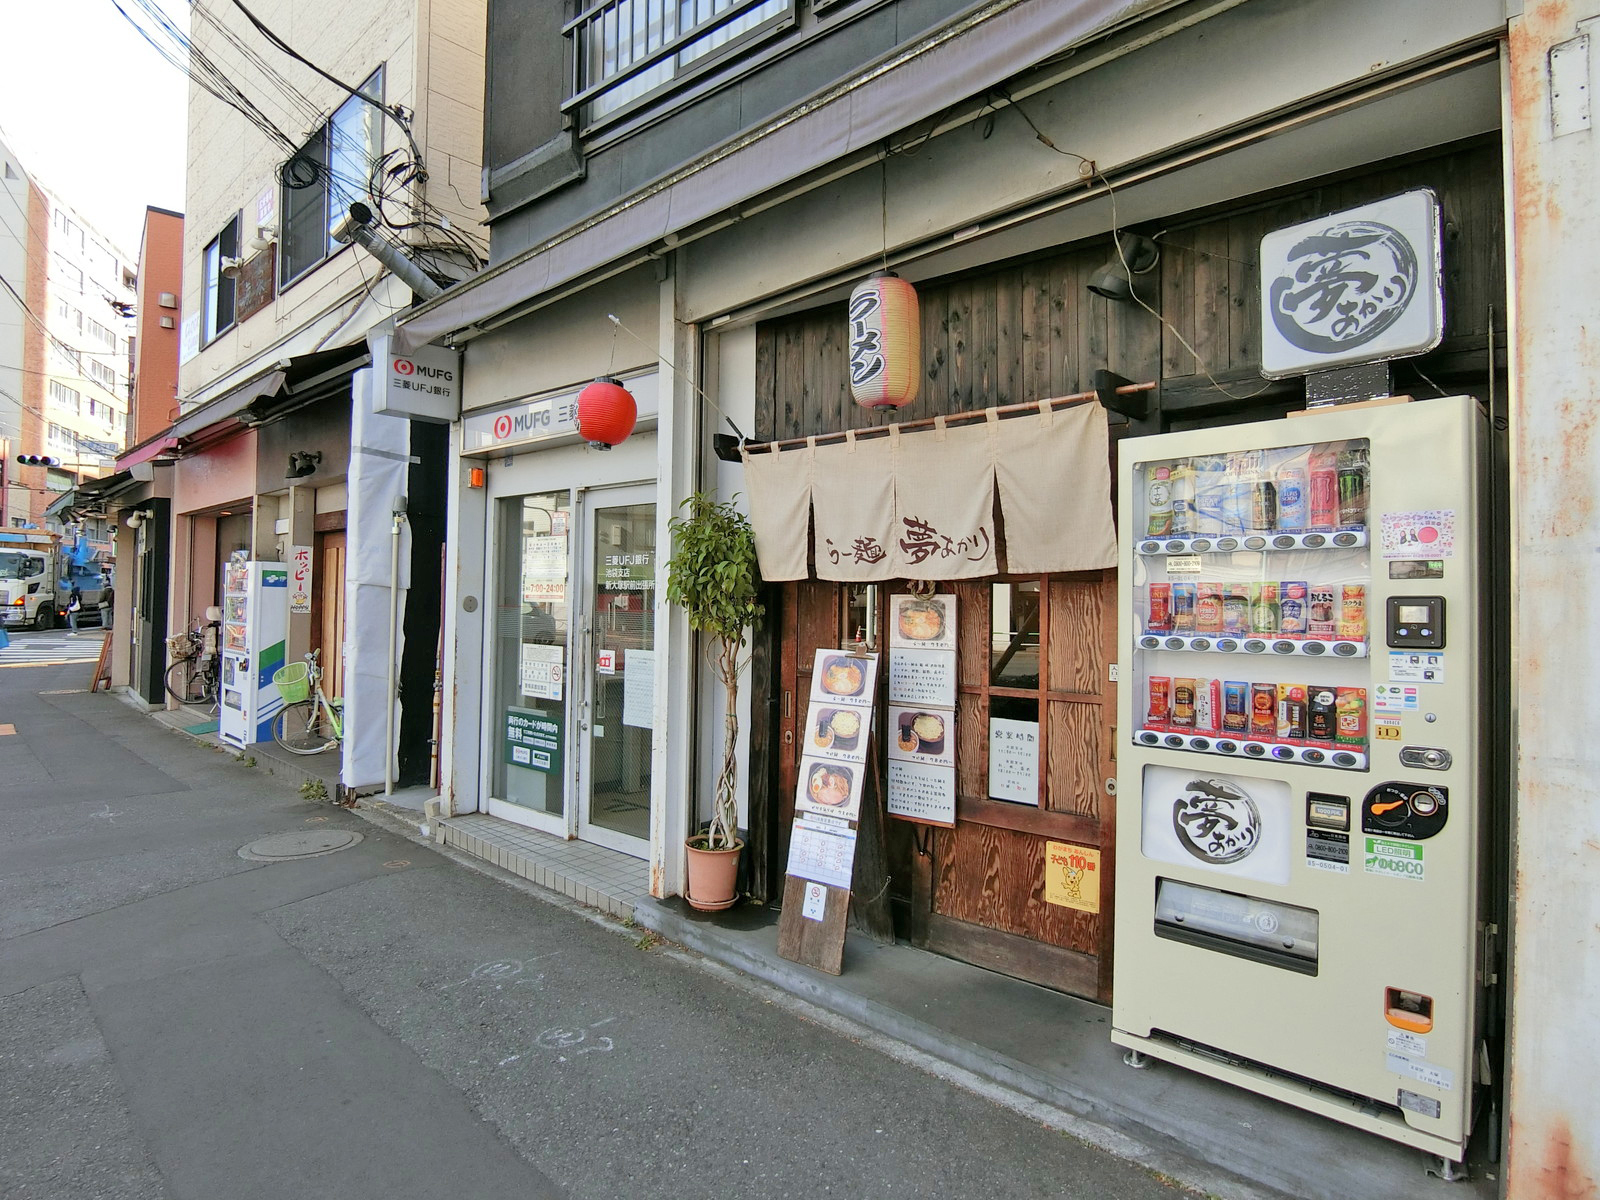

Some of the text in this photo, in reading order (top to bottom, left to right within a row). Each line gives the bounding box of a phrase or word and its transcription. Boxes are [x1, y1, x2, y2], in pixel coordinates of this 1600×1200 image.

[416, 365, 453, 382] MUFG
[393, 377, 452, 398] 三菱UFJ銀行
[514, 409, 551, 434] MUFG
[825, 515, 991, 566] らー麺 夢あかり
[605, 553, 650, 567] 三菱UFJ銀行
[294, 547, 310, 592] ホッピー
[605, 568, 631, 578] 池袋支店
[530, 583, 564, 595] 7:00-24:00
[1310, 593, 1334, 602] おしるこ
[1111, 665, 1118, 676] 入口
[1376, 846, 1411, 858] LED照明
